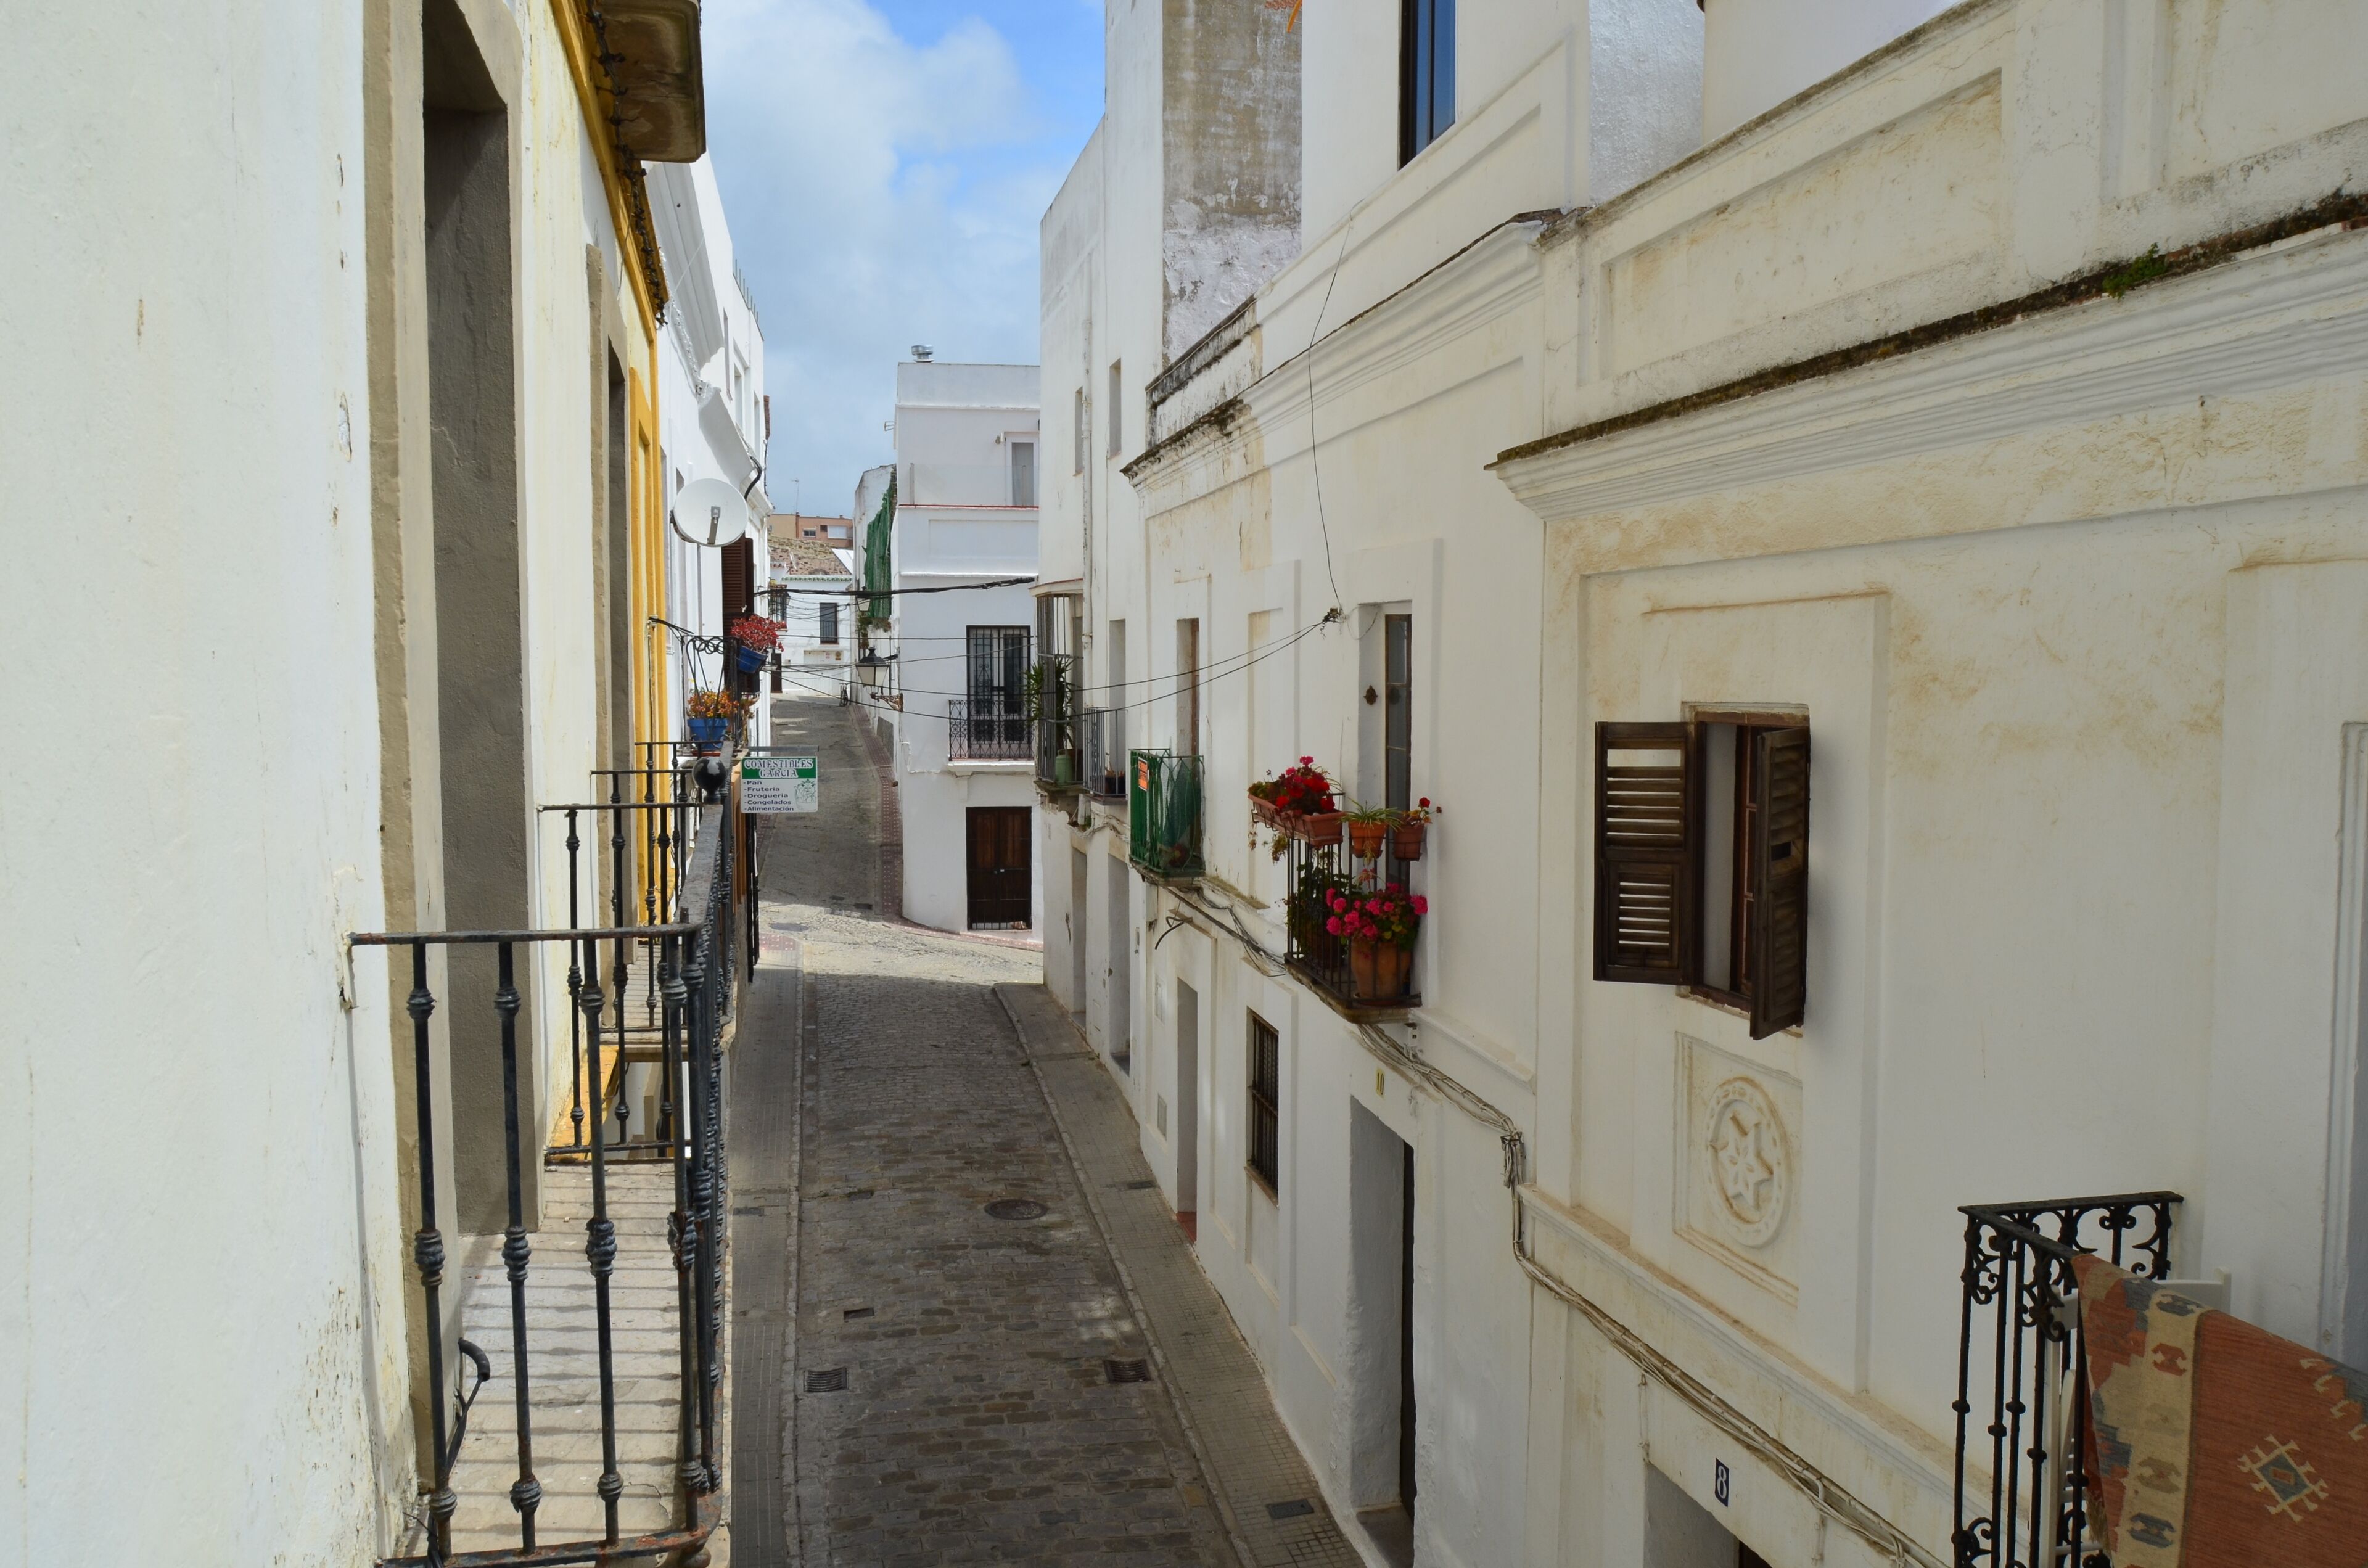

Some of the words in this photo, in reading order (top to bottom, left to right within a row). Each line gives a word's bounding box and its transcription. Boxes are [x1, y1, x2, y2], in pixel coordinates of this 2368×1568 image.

[744, 759, 813, 768] COMESTIBLES
[1377, 1072, 1384, 1096] 10
[1717, 1466, 1727, 1499] 8
